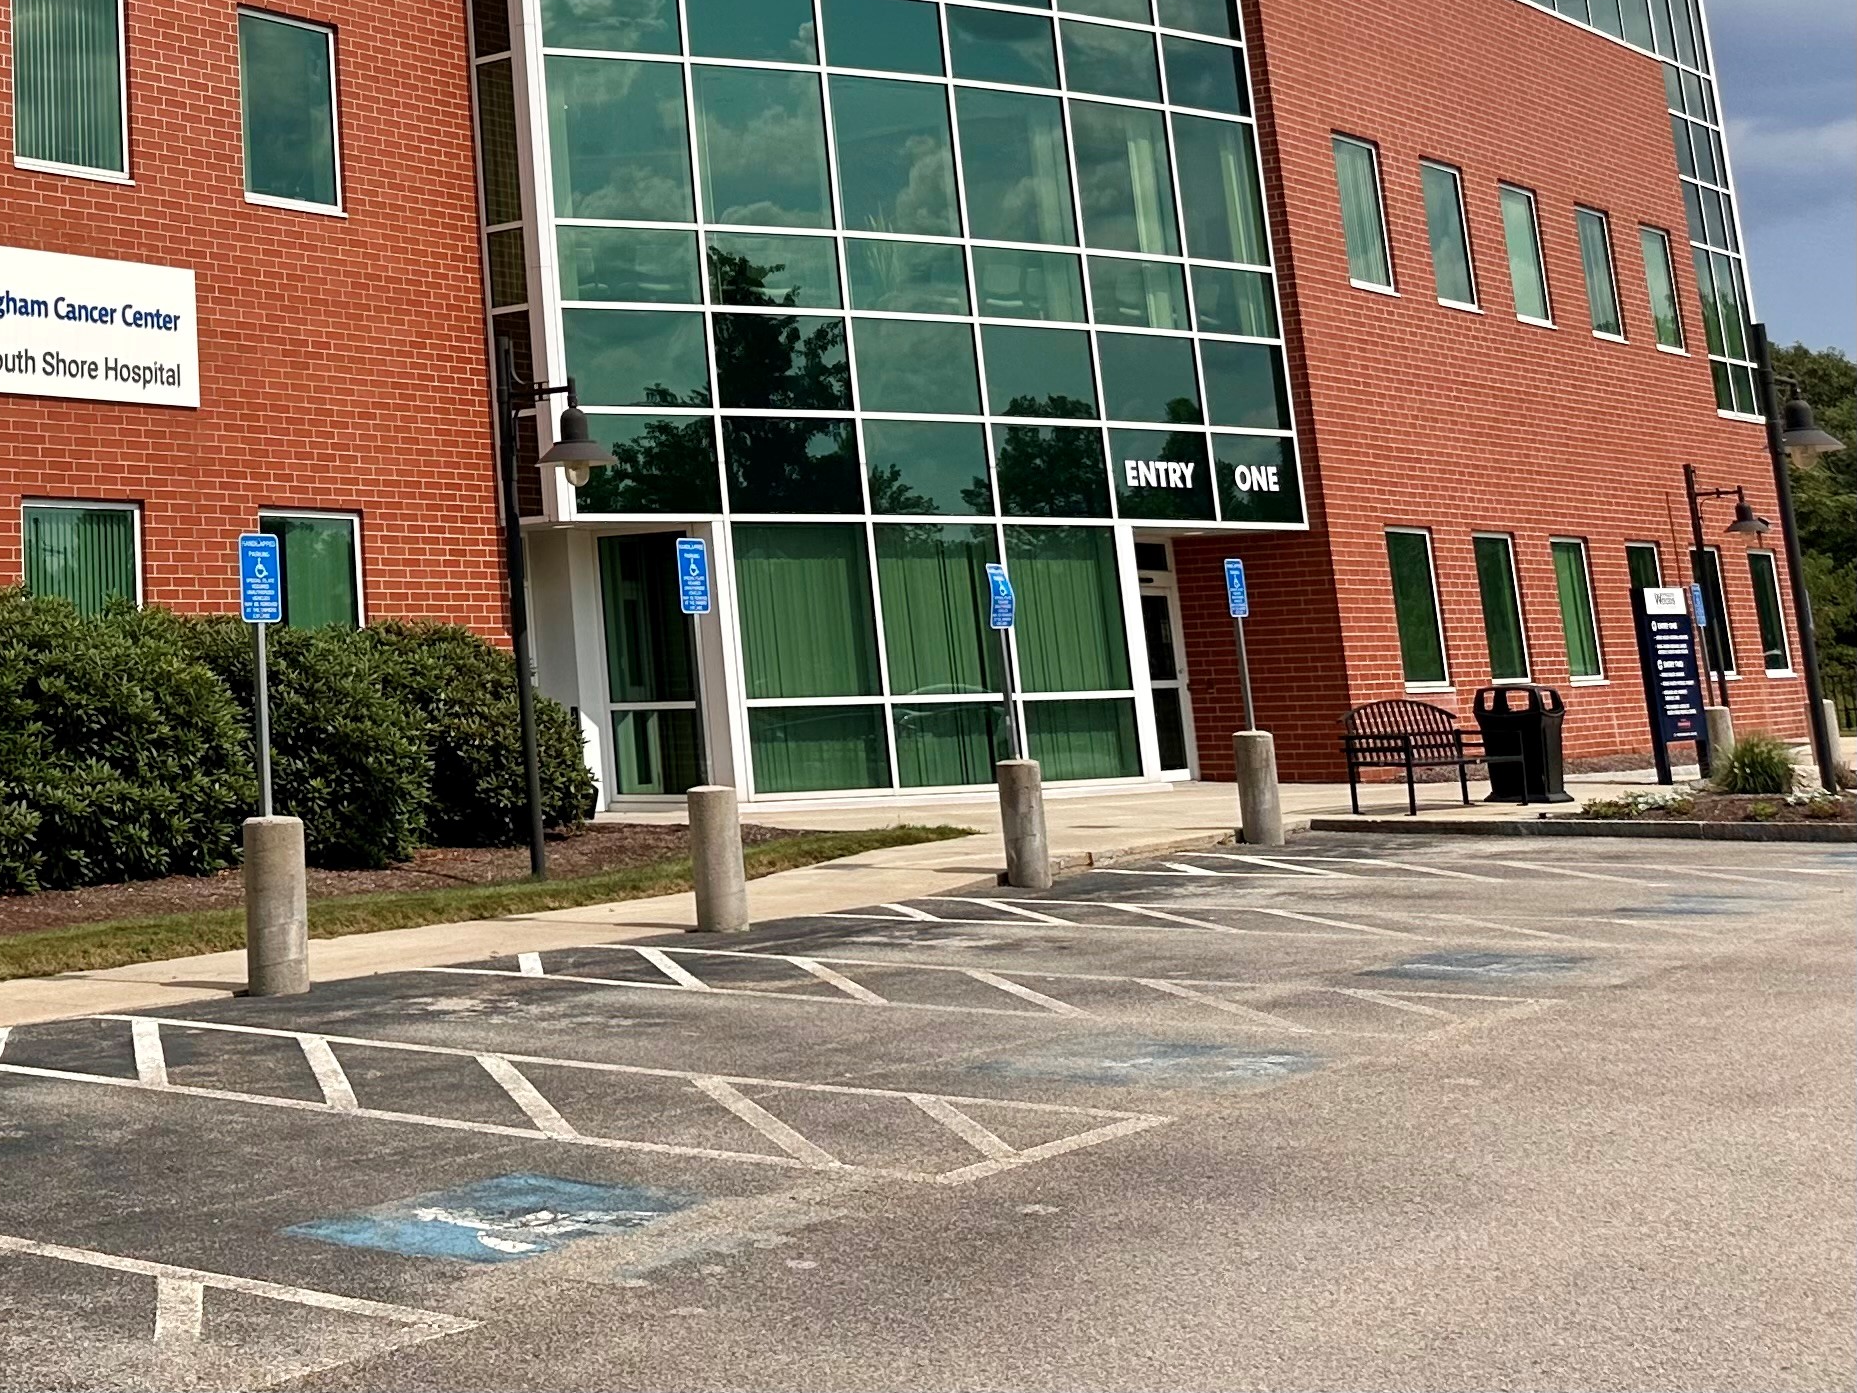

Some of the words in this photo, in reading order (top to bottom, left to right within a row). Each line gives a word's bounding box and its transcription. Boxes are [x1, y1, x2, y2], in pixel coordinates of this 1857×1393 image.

[54, 296, 117, 325] Cancer
[121, 304, 180, 332] Center
[42, 351, 99, 379] Shore
[105, 357, 181, 390] Hospital
[1124, 459, 1195, 489] ENTRY
[1234, 464, 1280, 492] ONE
